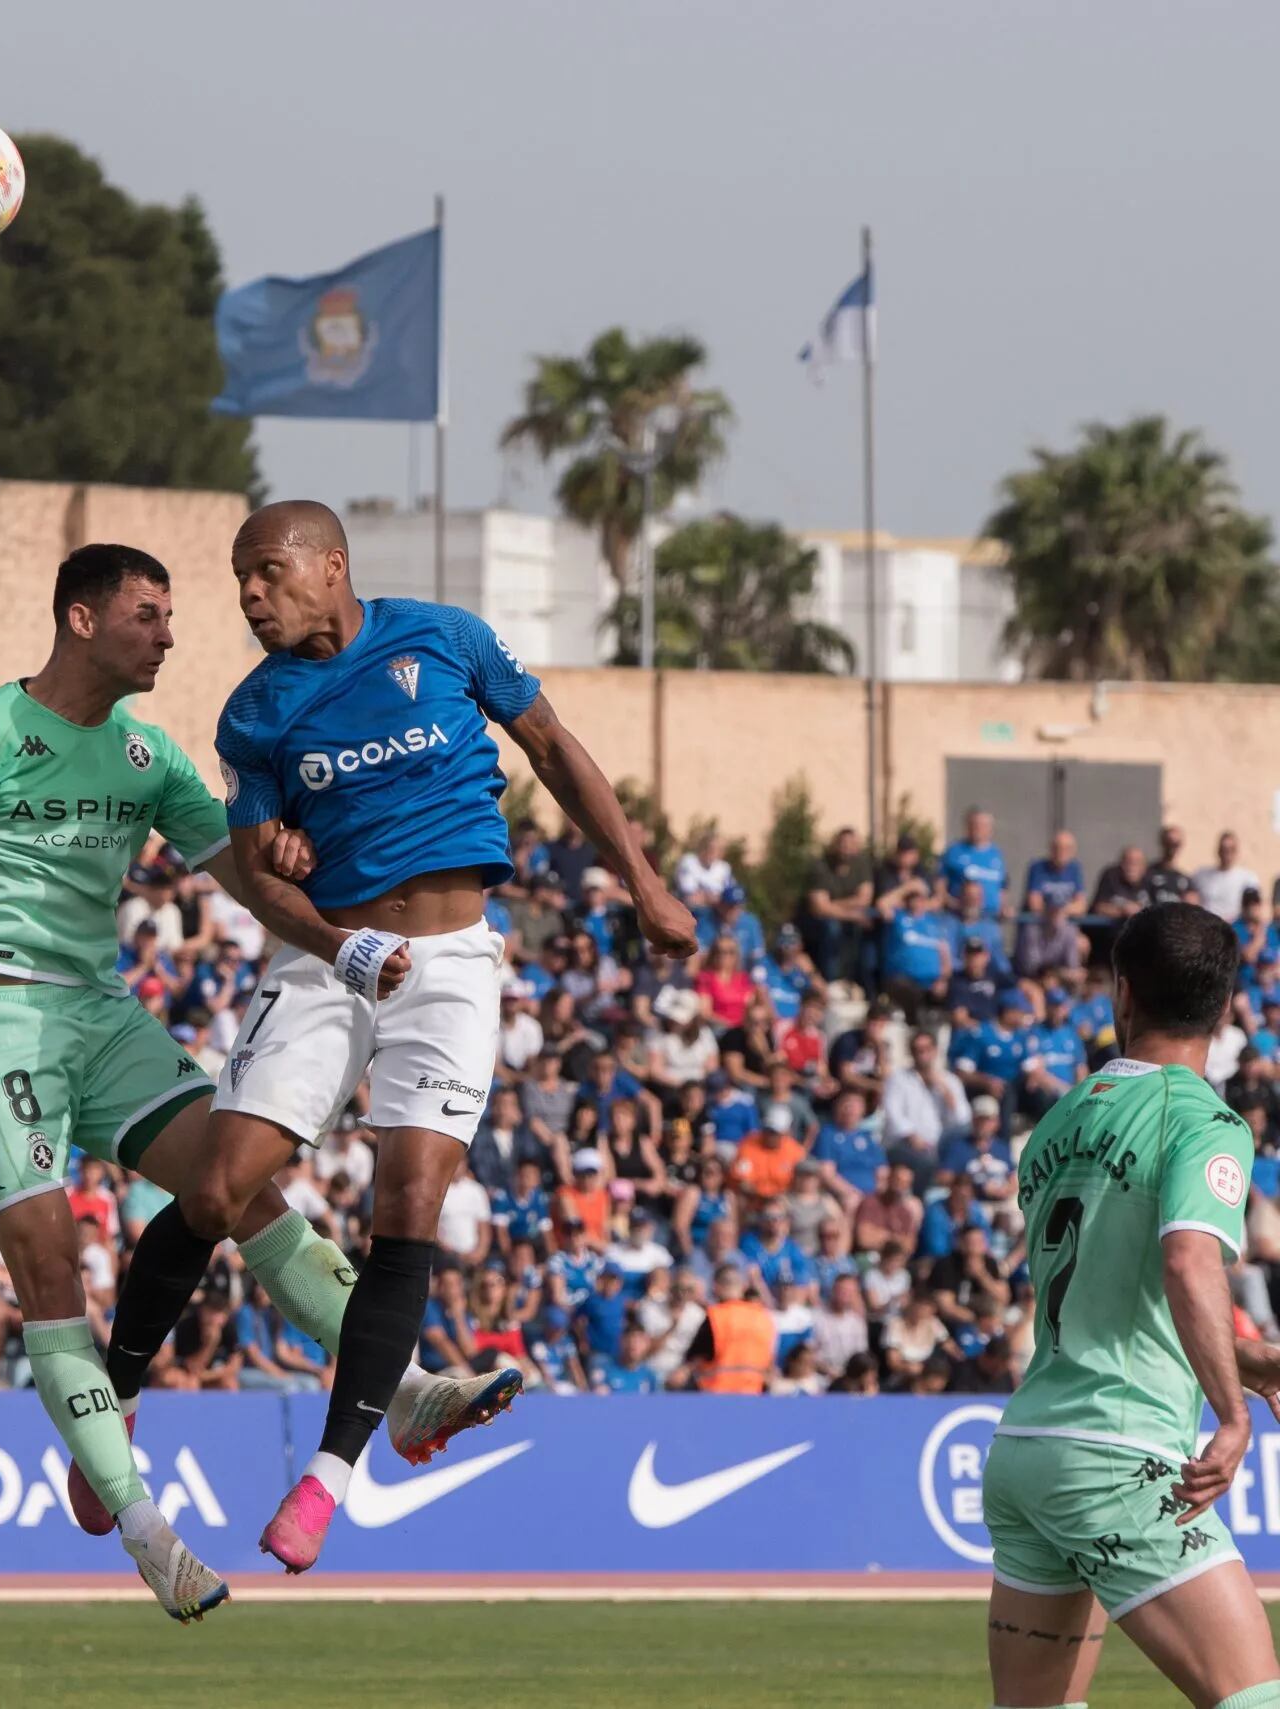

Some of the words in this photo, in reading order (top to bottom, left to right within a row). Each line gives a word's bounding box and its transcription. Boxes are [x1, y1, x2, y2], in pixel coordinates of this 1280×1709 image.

[337, 723, 449, 772] COASA
[33, 834, 129, 849] ACADEMY
[246, 990, 281, 1045] 7
[1, 1069, 42, 1125] 8
